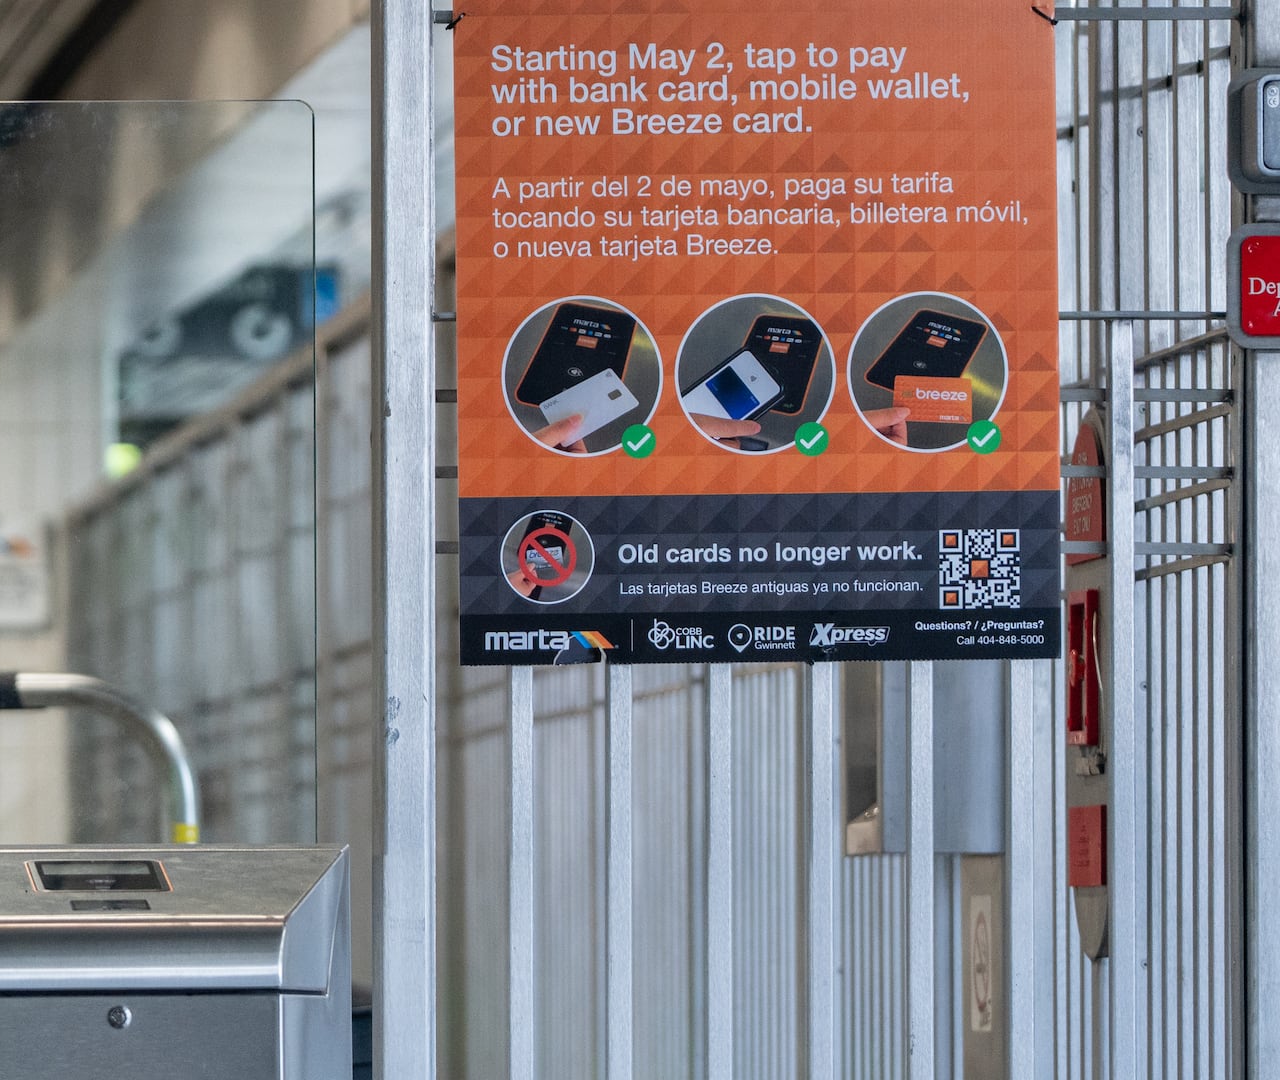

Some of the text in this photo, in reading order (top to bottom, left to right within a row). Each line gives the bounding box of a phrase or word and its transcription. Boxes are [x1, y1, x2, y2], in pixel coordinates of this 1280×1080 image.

[491, 42, 907, 78] Starting May 2, tap to pay
[491, 71, 969, 106] with bank card, mobile wallet,
[491, 106, 813, 137] or new Breeze card.
[492, 171, 954, 204] A partir del 2 de mayo, paga su tarifa
[492, 200, 1028, 232] tocando su tarjeta bancaria, billetera móvil,
[493, 233, 778, 262] o nueva tarjeta Breeze.
[573, 318, 600, 328] marta
[915, 387, 968, 401] breeze
[618, 540, 923, 566] Old cards no longer work.
[619, 579, 924, 598] Las tarjetas Breeze antiguas ya no funcionan.
[675, 627, 703, 636] COBB
[754, 626, 796, 641] RIDE
[809, 623, 888, 647] Xpress
[914, 619, 1045, 632] Questions? / ¿Preguntas?
[484, 628, 570, 651] marta
[675, 634, 715, 649] LINC
[754, 640, 796, 650] Gwinnett
[956, 634, 1045, 646] Call 404-848-5000
